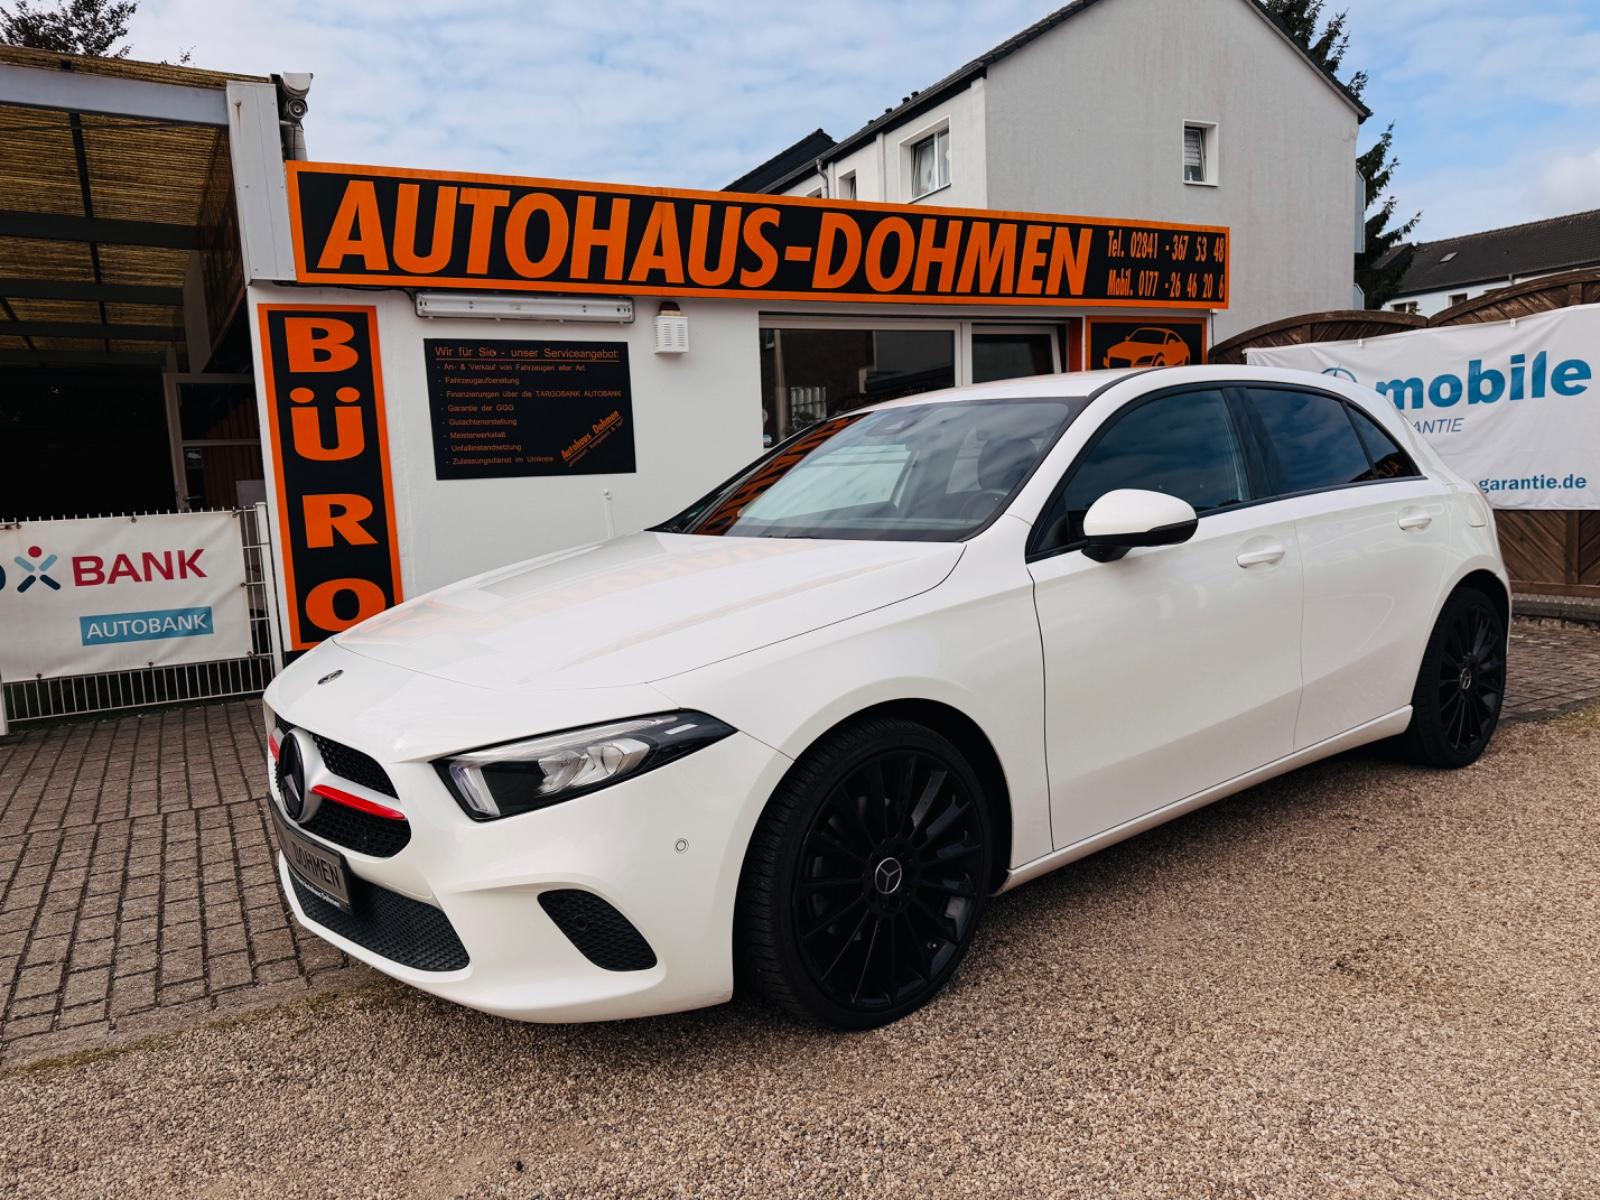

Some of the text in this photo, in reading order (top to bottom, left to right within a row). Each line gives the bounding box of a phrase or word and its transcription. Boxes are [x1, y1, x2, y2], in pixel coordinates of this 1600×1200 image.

[316, 180, 1093, 297] AUTOHAUS-DOHMEN
[1108, 230, 1125, 258] Tel.
[1130, 231, 1159, 259] 02841
[1195, 236, 1208, 262] 53
[1213, 237, 1225, 263] 48
[1107, 268, 1134, 296] Mobil.
[1138, 269, 1160, 297] 0177
[1187, 273, 1198, 299] 46
[1202, 273, 1213, 299] 20
[435, 346, 453, 357] Wir
[459, 346, 473, 357] für
[479, 346, 496, 357] Sie
[511, 348, 538, 358] unser
[503, 390, 519, 398] über
[536, 390, 580, 398] TARGOBANK
[584, 390, 622, 398] AUTOBANK
[1375, 350, 1593, 411] mobile
[447, 404, 478, 412] Garantie
[481, 403, 492, 412] der
[284, 317, 386, 632] BÜRO
[72, 548, 208, 587] BANK
[86, 613, 208, 640] AUTOBANK
